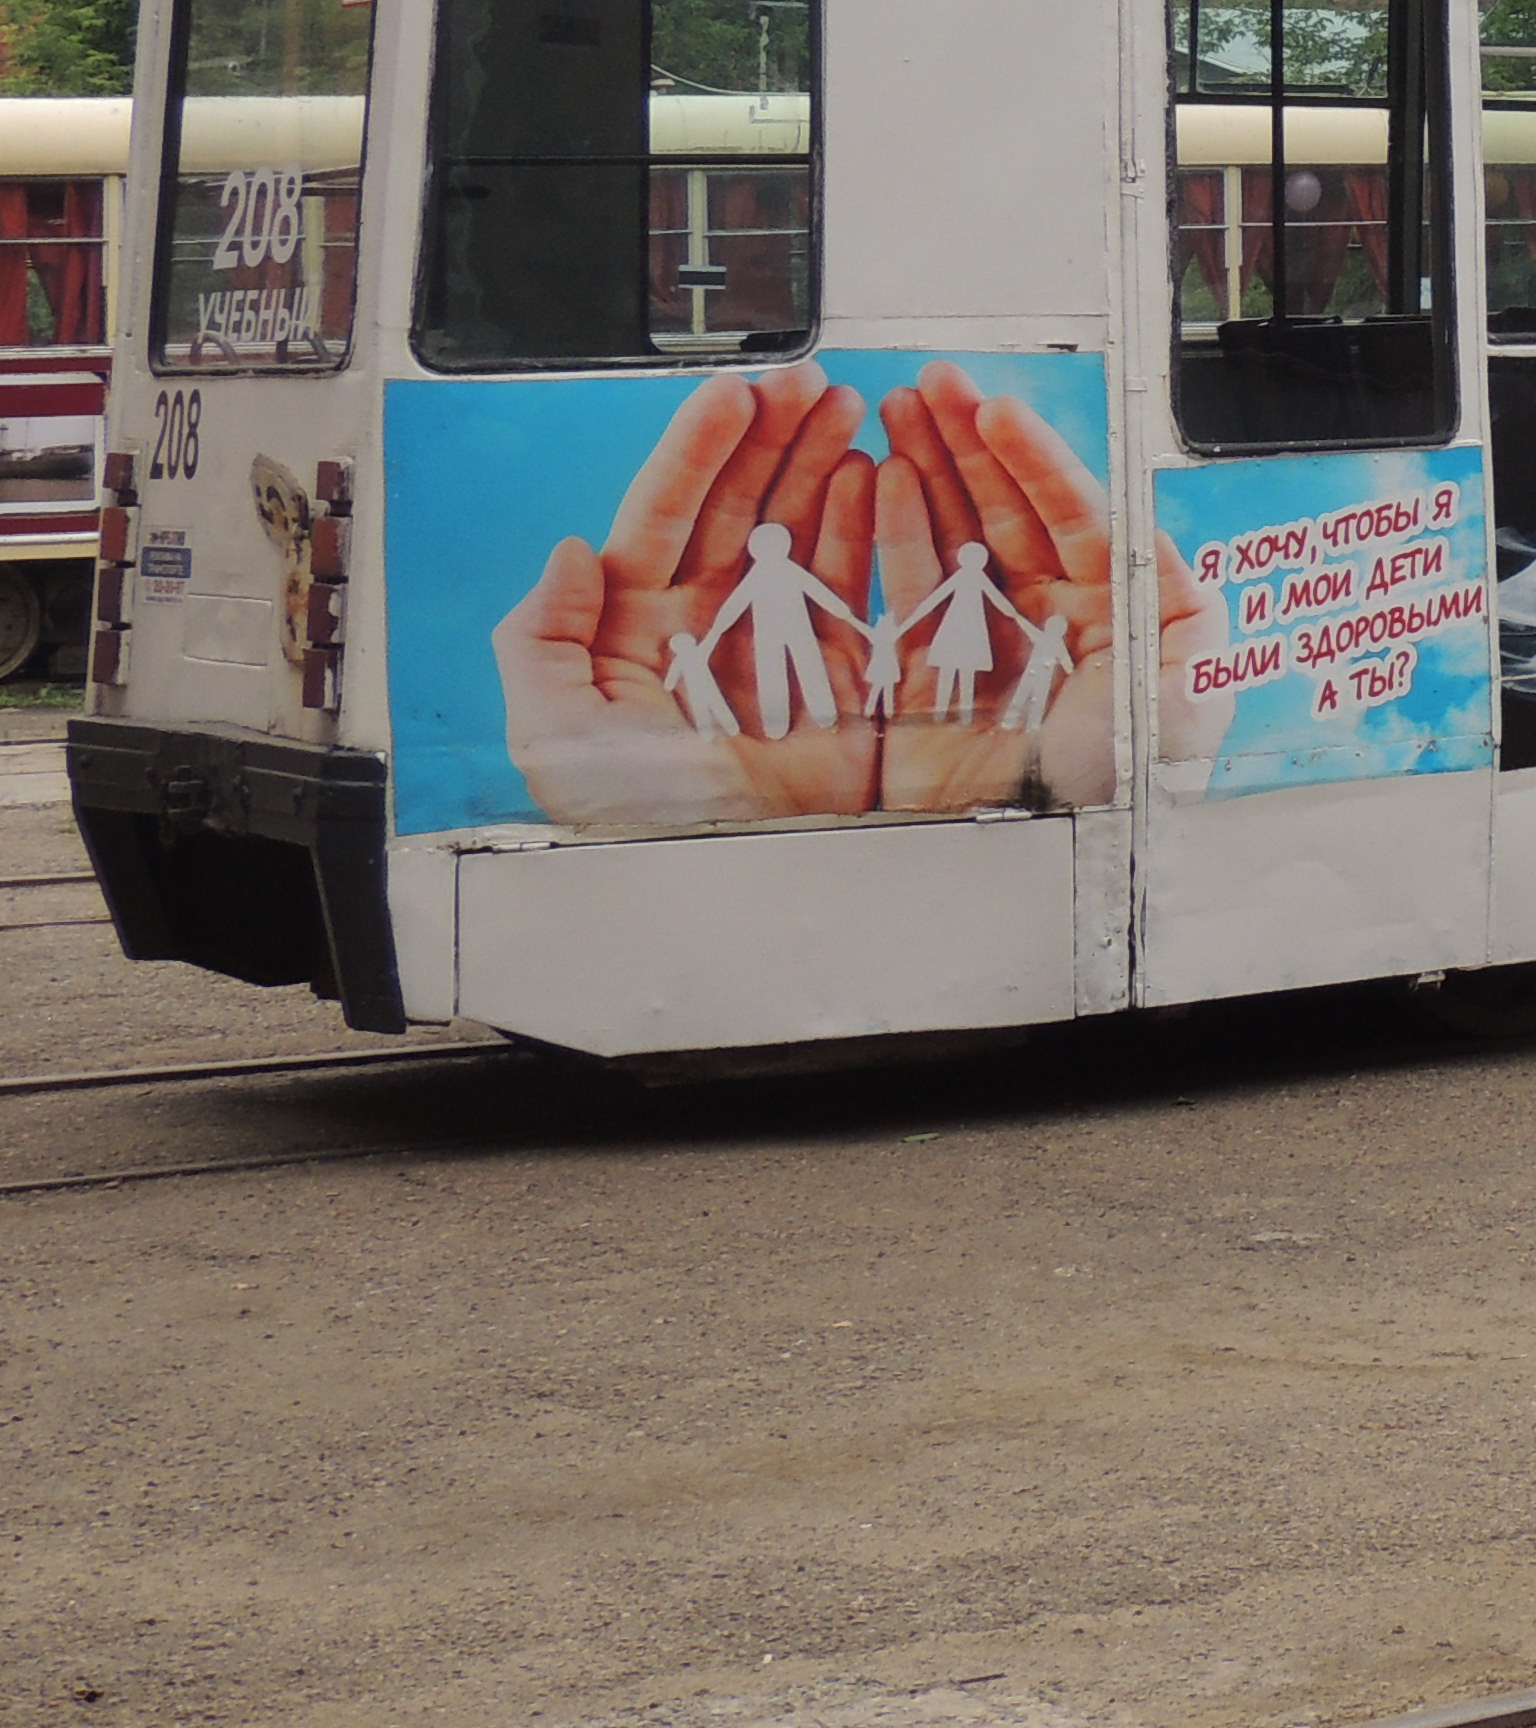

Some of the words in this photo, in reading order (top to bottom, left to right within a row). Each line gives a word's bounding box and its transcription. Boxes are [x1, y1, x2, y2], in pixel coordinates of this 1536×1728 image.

[212, 165, 301, 270] 208
[150, 389, 201, 480] 208
[1199, 549, 1219, 584] Я
[1322, 498, 1419, 548] ЧТОБЫ
[1433, 489, 1453, 520] Я
[1245, 591, 1267, 624] И
[1282, 569, 1351, 615] МОИ
[1366, 545, 1442, 600] ДЕТИ
[1192, 642, 1280, 695] БЫЛИ
[1296, 585, 1482, 667] ЗДОРОВЫМИ
[1318, 680, 1338, 713] А
[1351, 651, 1411, 701] ТЫ?
